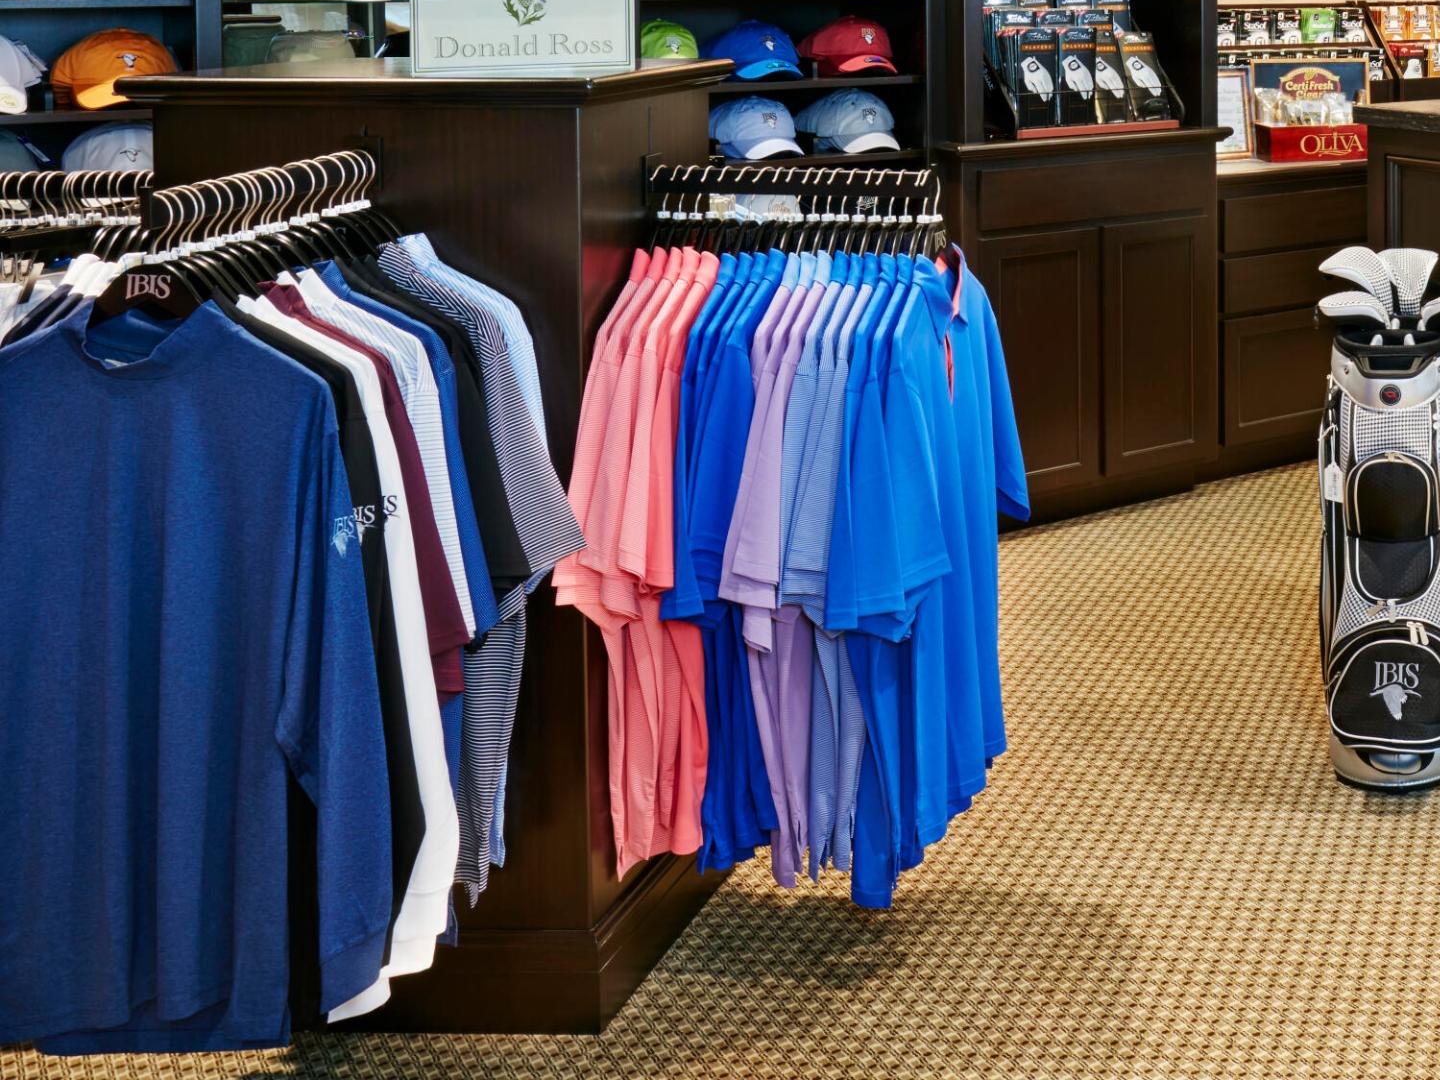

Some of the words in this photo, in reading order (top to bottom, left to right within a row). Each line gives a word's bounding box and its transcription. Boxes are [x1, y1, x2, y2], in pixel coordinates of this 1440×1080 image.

[434, 34, 538, 59] Donald
[549, 33, 614, 56] Ross
[1301, 132, 1364, 156] OLIVA
[125, 273, 172, 300] IBIS
[1374, 660, 1420, 688] IBIS
